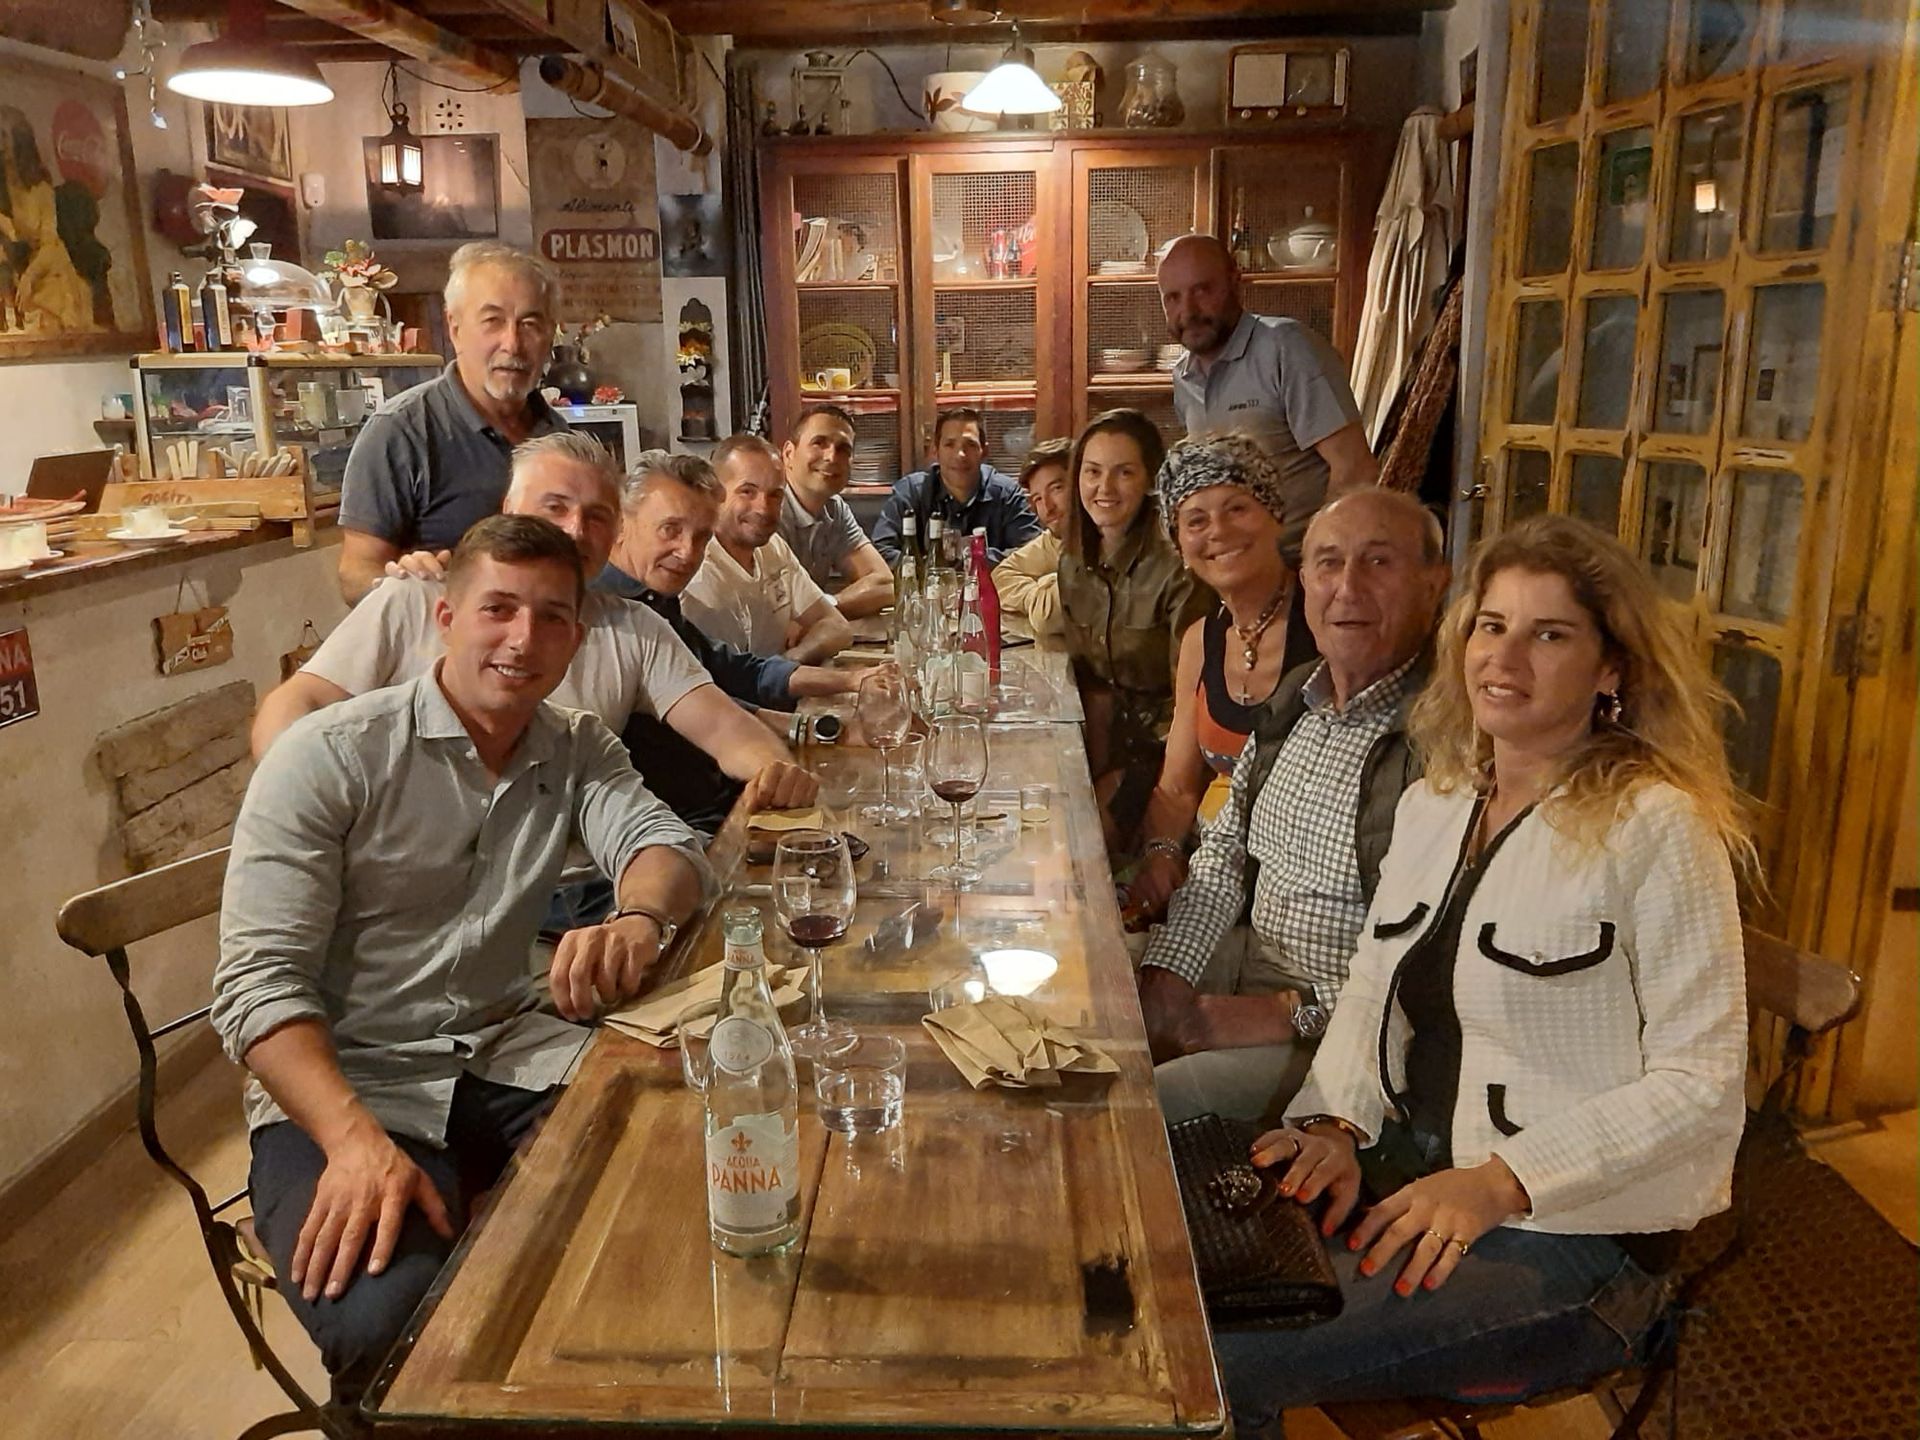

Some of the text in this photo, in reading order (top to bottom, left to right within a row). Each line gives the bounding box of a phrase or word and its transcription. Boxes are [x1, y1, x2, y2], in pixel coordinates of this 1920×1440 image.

[550, 233, 654, 259] PLASMON
[0, 680, 27, 716] 51
[726, 1155, 761, 1168] ACQUA
[711, 1163, 783, 1194] PANNA
